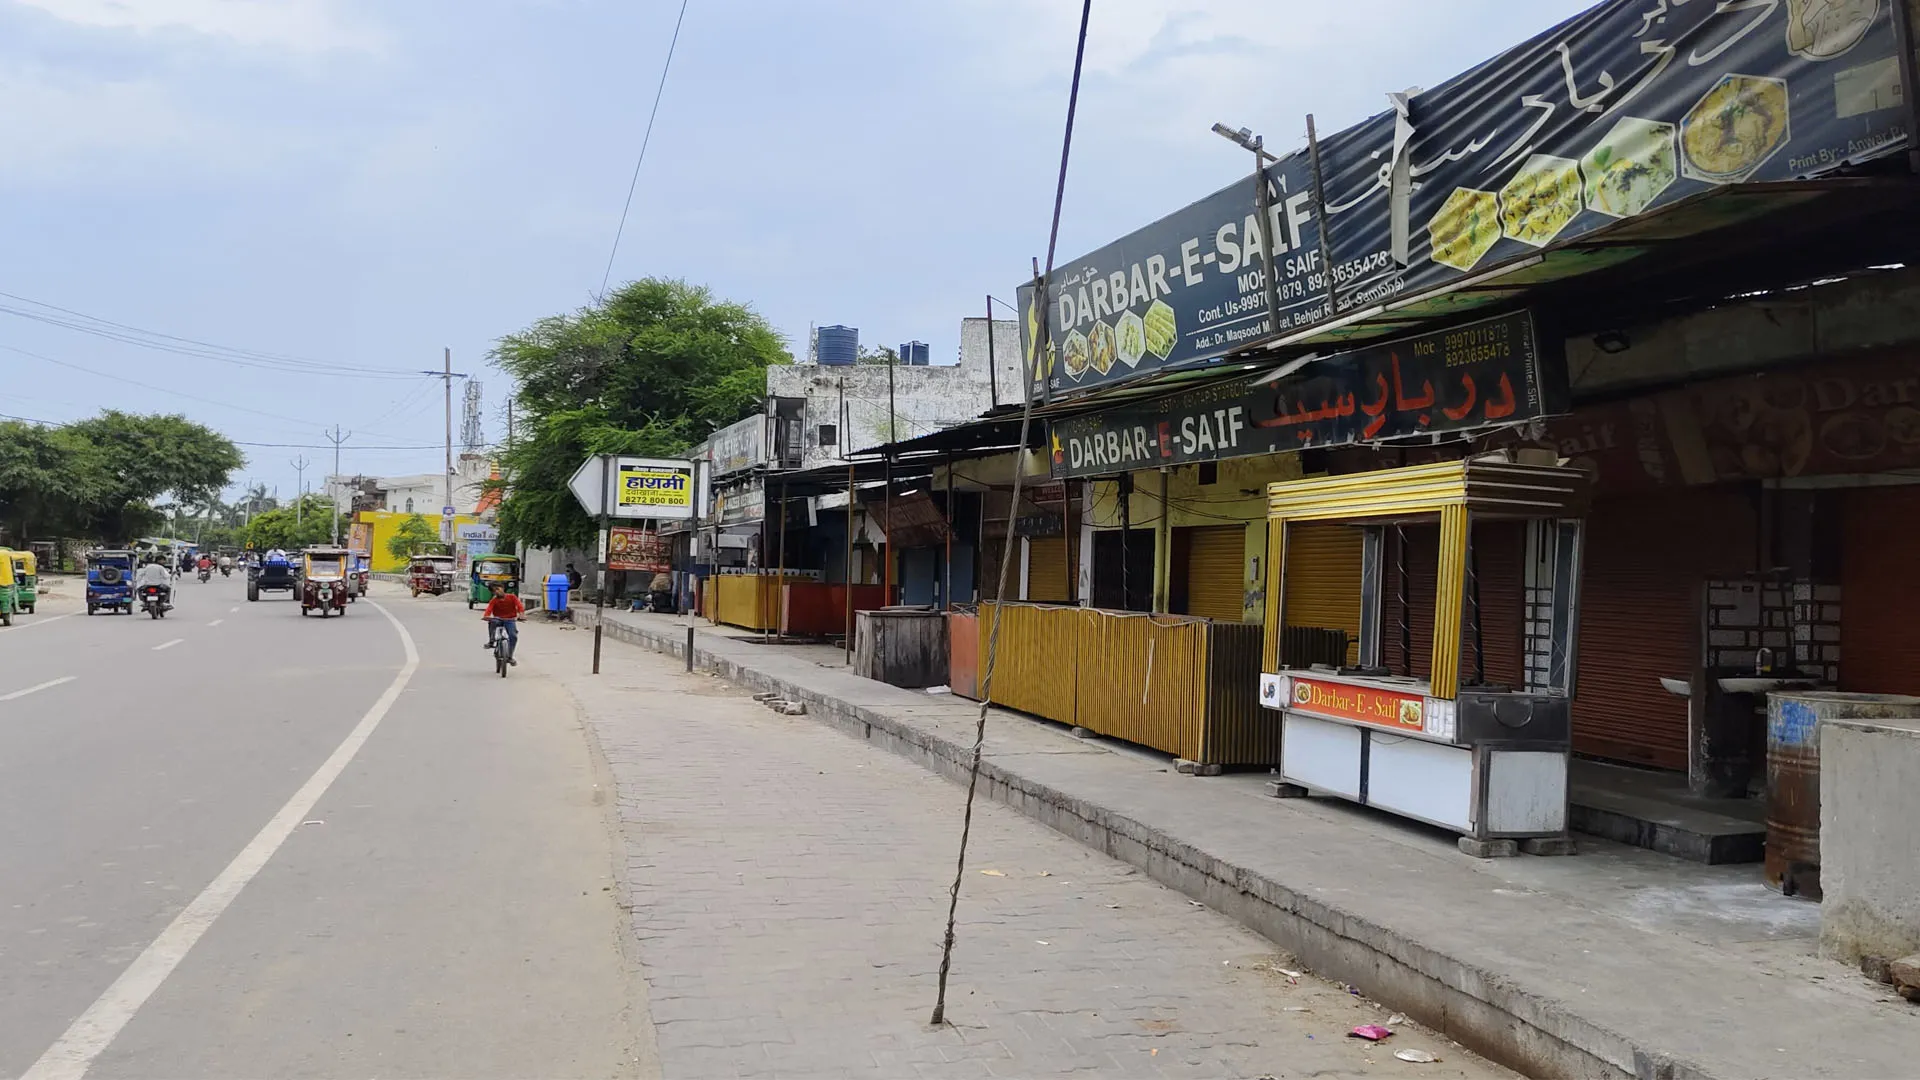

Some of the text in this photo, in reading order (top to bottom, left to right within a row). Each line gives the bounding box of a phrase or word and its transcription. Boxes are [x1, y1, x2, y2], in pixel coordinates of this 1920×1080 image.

[1788, 156, 1819, 171] Print
[1058, 190, 1312, 332] DARBAR-E-SAIF
[1286, 248, 1320, 279] SAIF
[1198, 305, 1224, 325] Cont.
[1226, 321, 1262, 342] Maqsood
[1444, 322, 1510, 352] 9997011879
[1445, 340, 1511, 368] 8923655478
[1069, 405, 1243, 469] DARBAR-E-SAIF
[625, 474, 686, 490] हाशमी
[625, 496, 647, 504] 8272
[1311, 685, 1350, 710] Darbar
[1374, 696, 1399, 719] Saif
